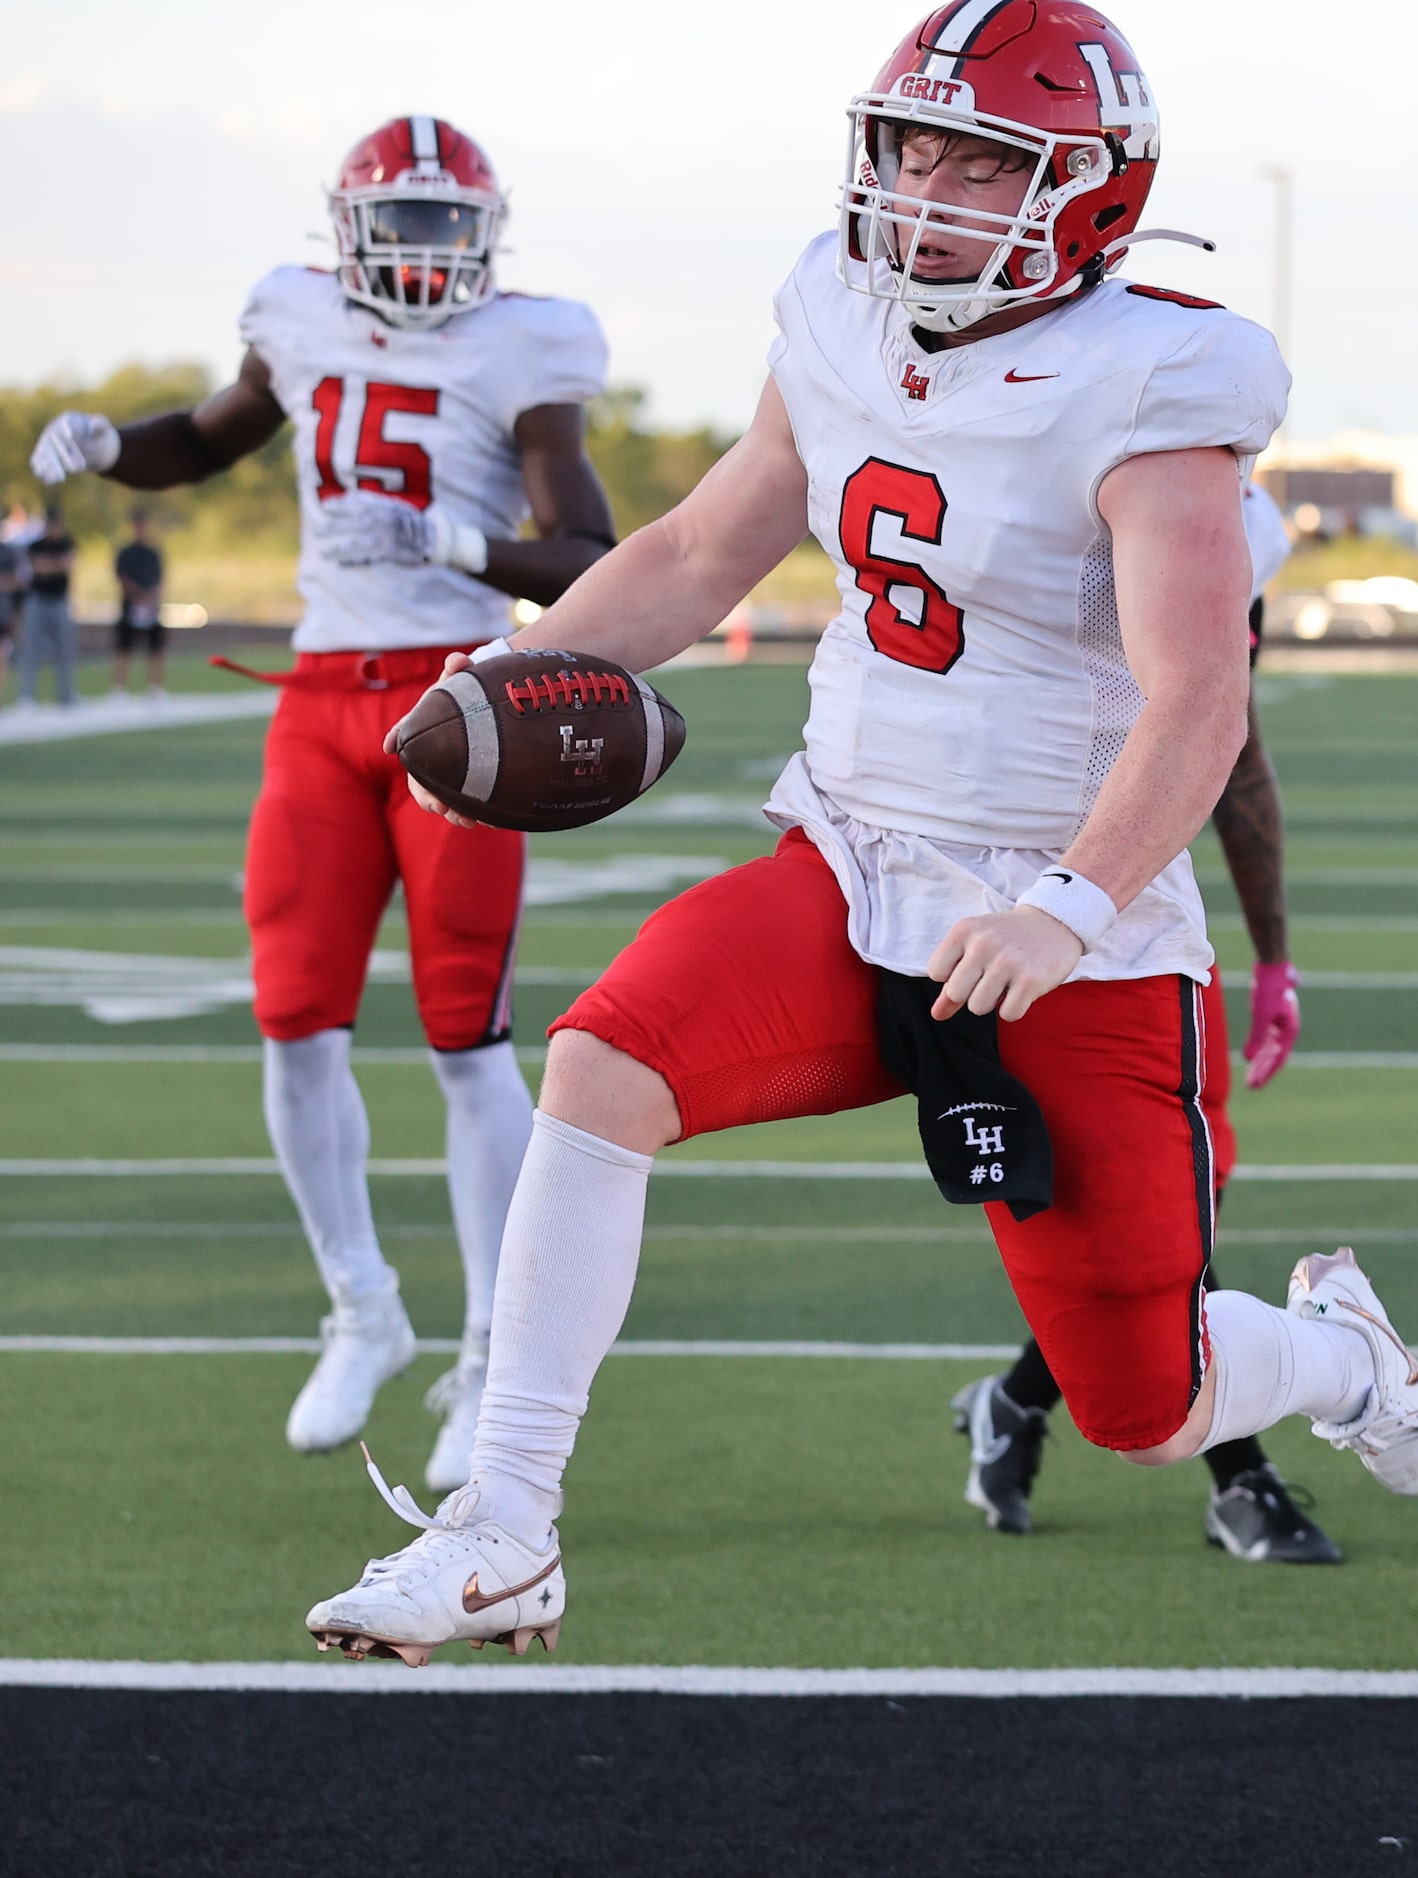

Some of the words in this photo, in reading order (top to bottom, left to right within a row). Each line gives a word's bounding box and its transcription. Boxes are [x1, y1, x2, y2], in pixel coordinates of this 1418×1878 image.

[899, 76, 962, 105] GRIT
[900, 363, 930, 402] LH
[312, 376, 440, 511] 15
[838, 455, 966, 676] 6
[559, 724, 604, 776] LH
[962, 1117, 1006, 1155] LH
[969, 1162, 1005, 1185] #6
